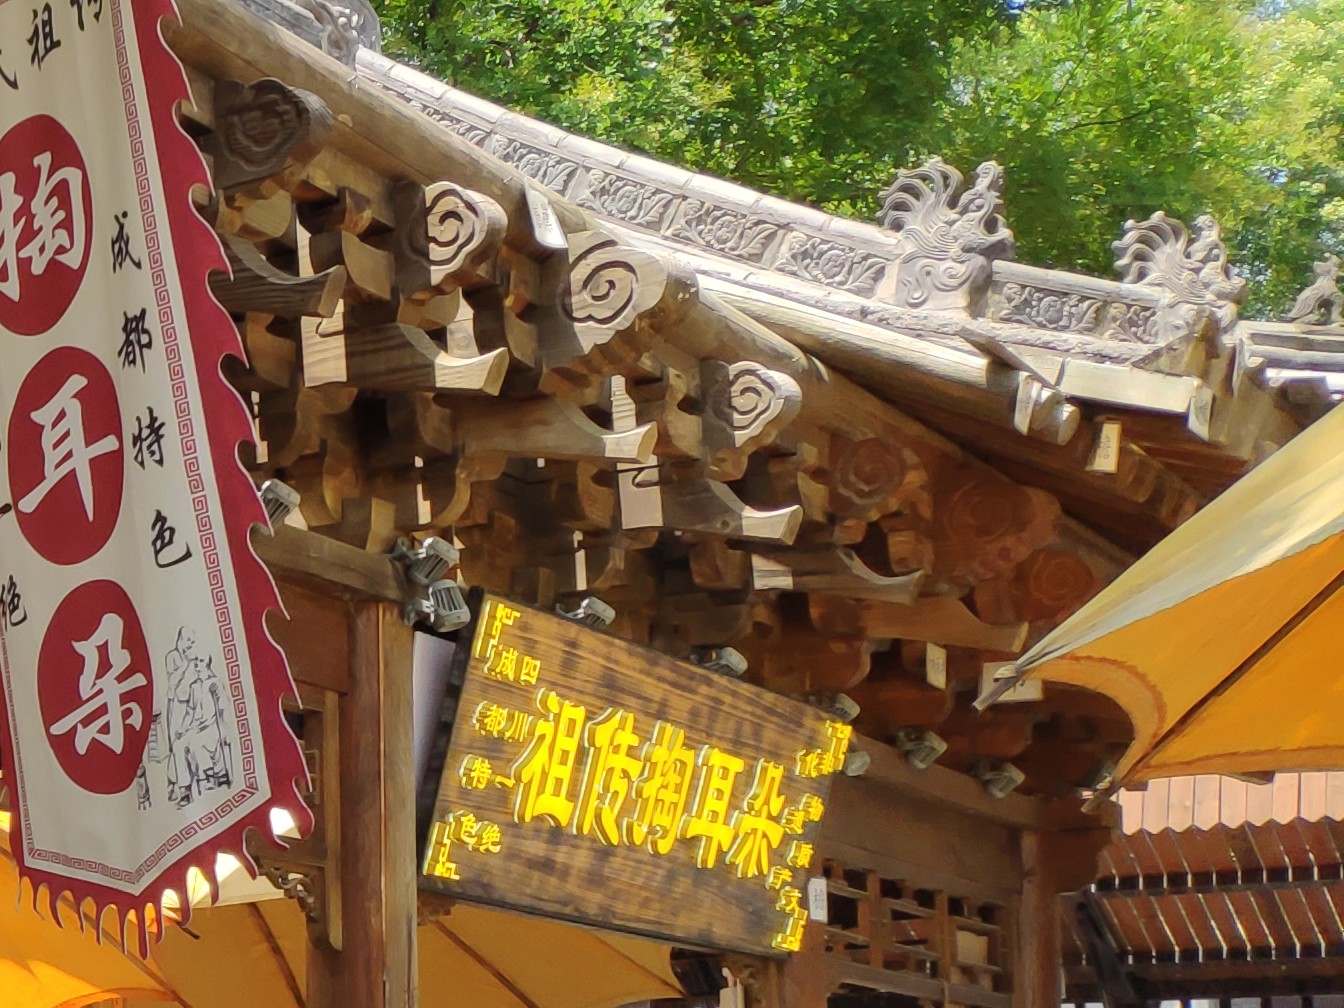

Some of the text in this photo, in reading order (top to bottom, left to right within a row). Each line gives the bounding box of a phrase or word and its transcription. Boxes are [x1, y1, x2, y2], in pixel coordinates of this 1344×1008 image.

[111, 210, 193, 568] 成都特色
[460, 646, 518, 850] 成都特色
[480, 655, 542, 854] 四川一绝
[513, 687, 786, 879] 祖传掏耳朵
